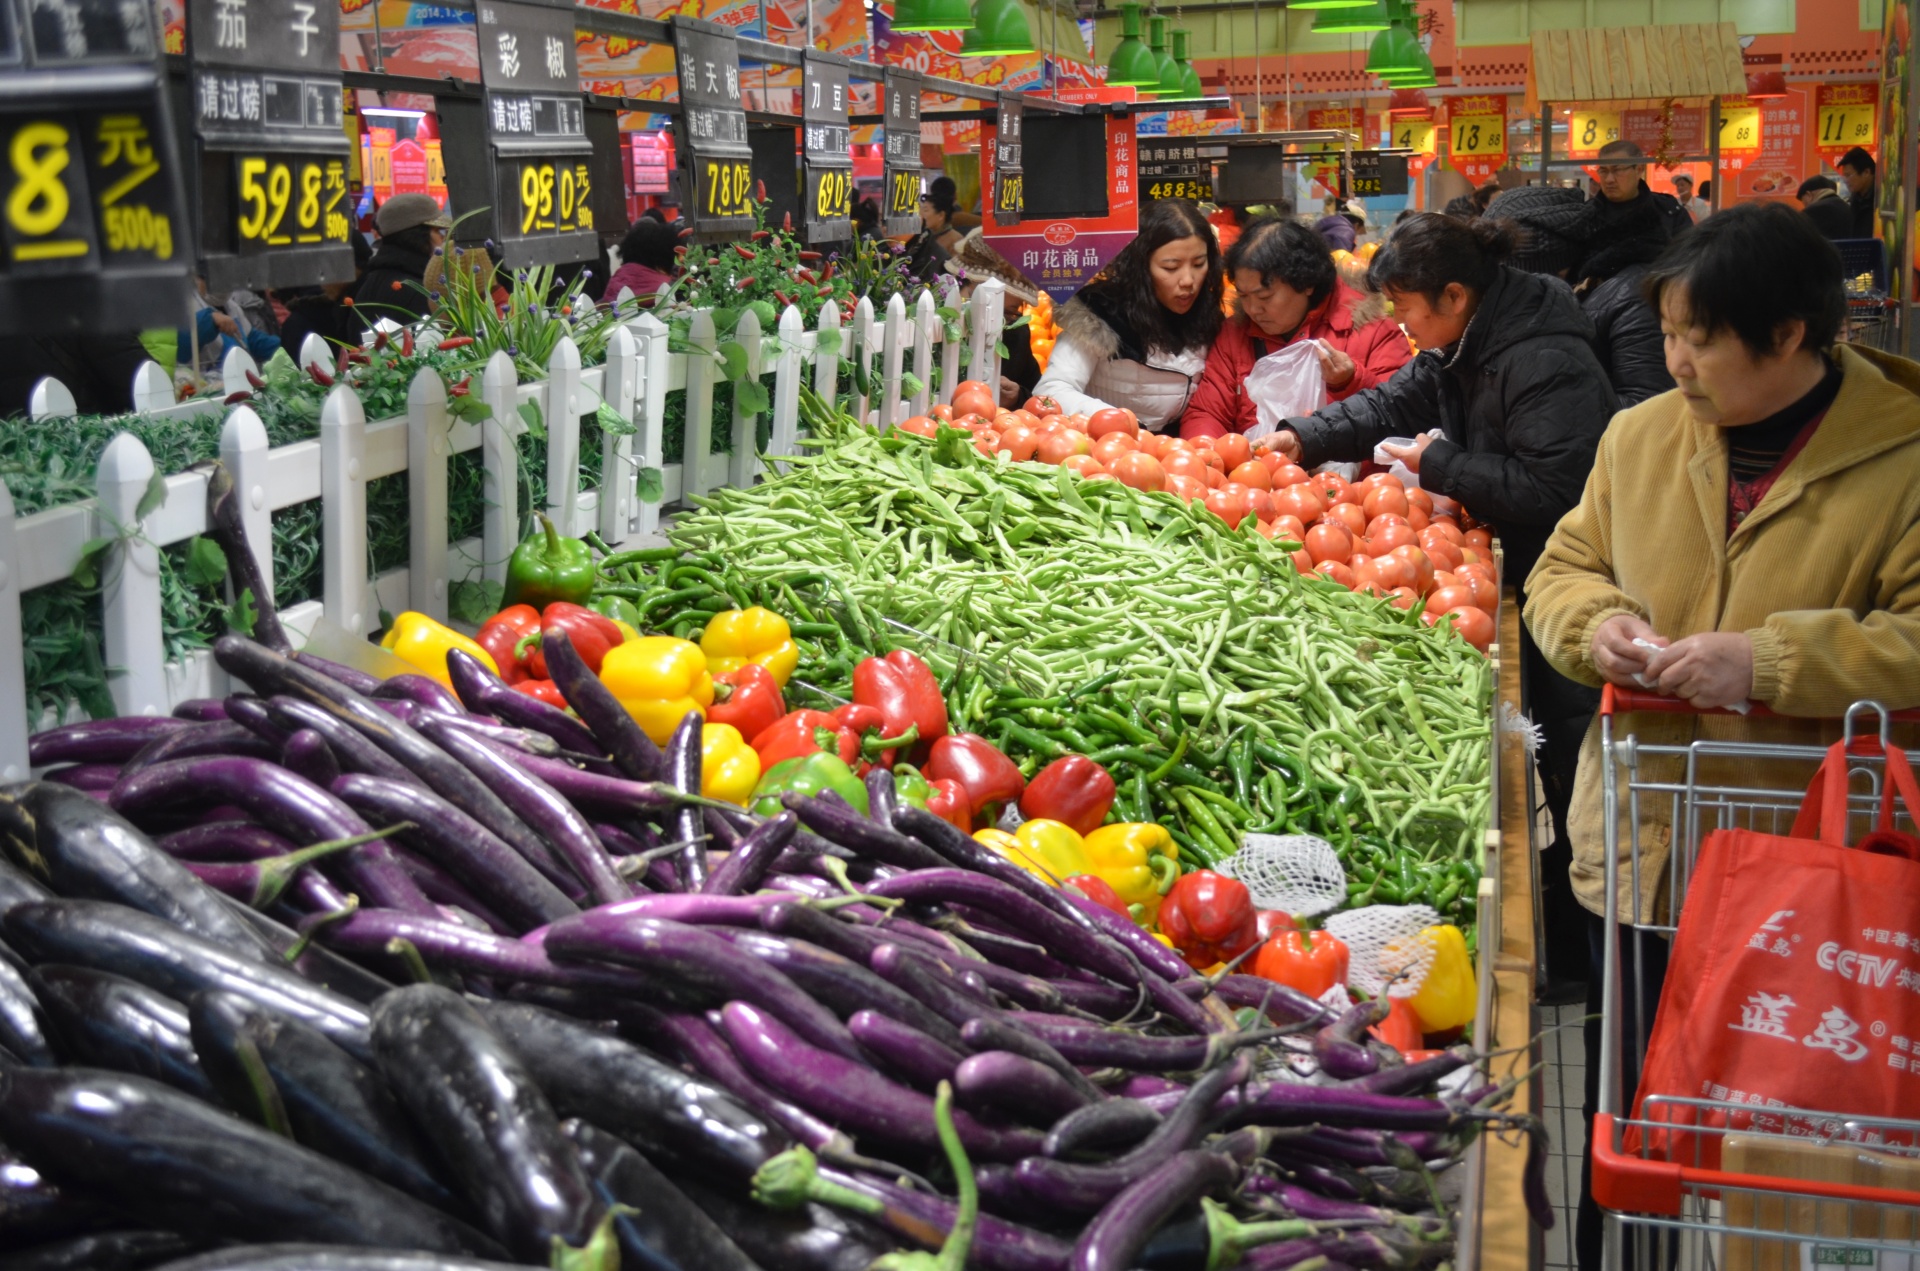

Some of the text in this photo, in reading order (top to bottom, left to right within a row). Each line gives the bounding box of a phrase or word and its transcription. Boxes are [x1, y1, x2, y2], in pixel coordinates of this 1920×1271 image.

[217, 0, 319, 57] 茄子
[498, 34, 567, 79] 彩椒
[682, 54, 741, 100] 指天椒
[201, 76, 260, 121] 请过磅
[811, 82, 842, 112] 刀豆
[493, 98, 532, 133] 请过磅
[1823, 113, 1869, 141] 11 98
[1456, 124, 1501, 151] 13 88
[1582, 118, 1597, 146] 8
[1736, 127, 1750, 140] 88
[1114, 132, 1129, 194] 印花商品
[1465, 164, 1490, 176] 促销
[6, 121, 70, 236] 8
[1149, 183, 1185, 199] 4.88
[104, 206, 173, 260] 500g
[326, 213, 348, 243] 500g
[577, 207, 593, 231] 500g
[1023, 248, 1099, 270] 印花商品
[1042, 269, 1083, 278] 会员独享
[1816, 940, 1898, 988] CCTV
